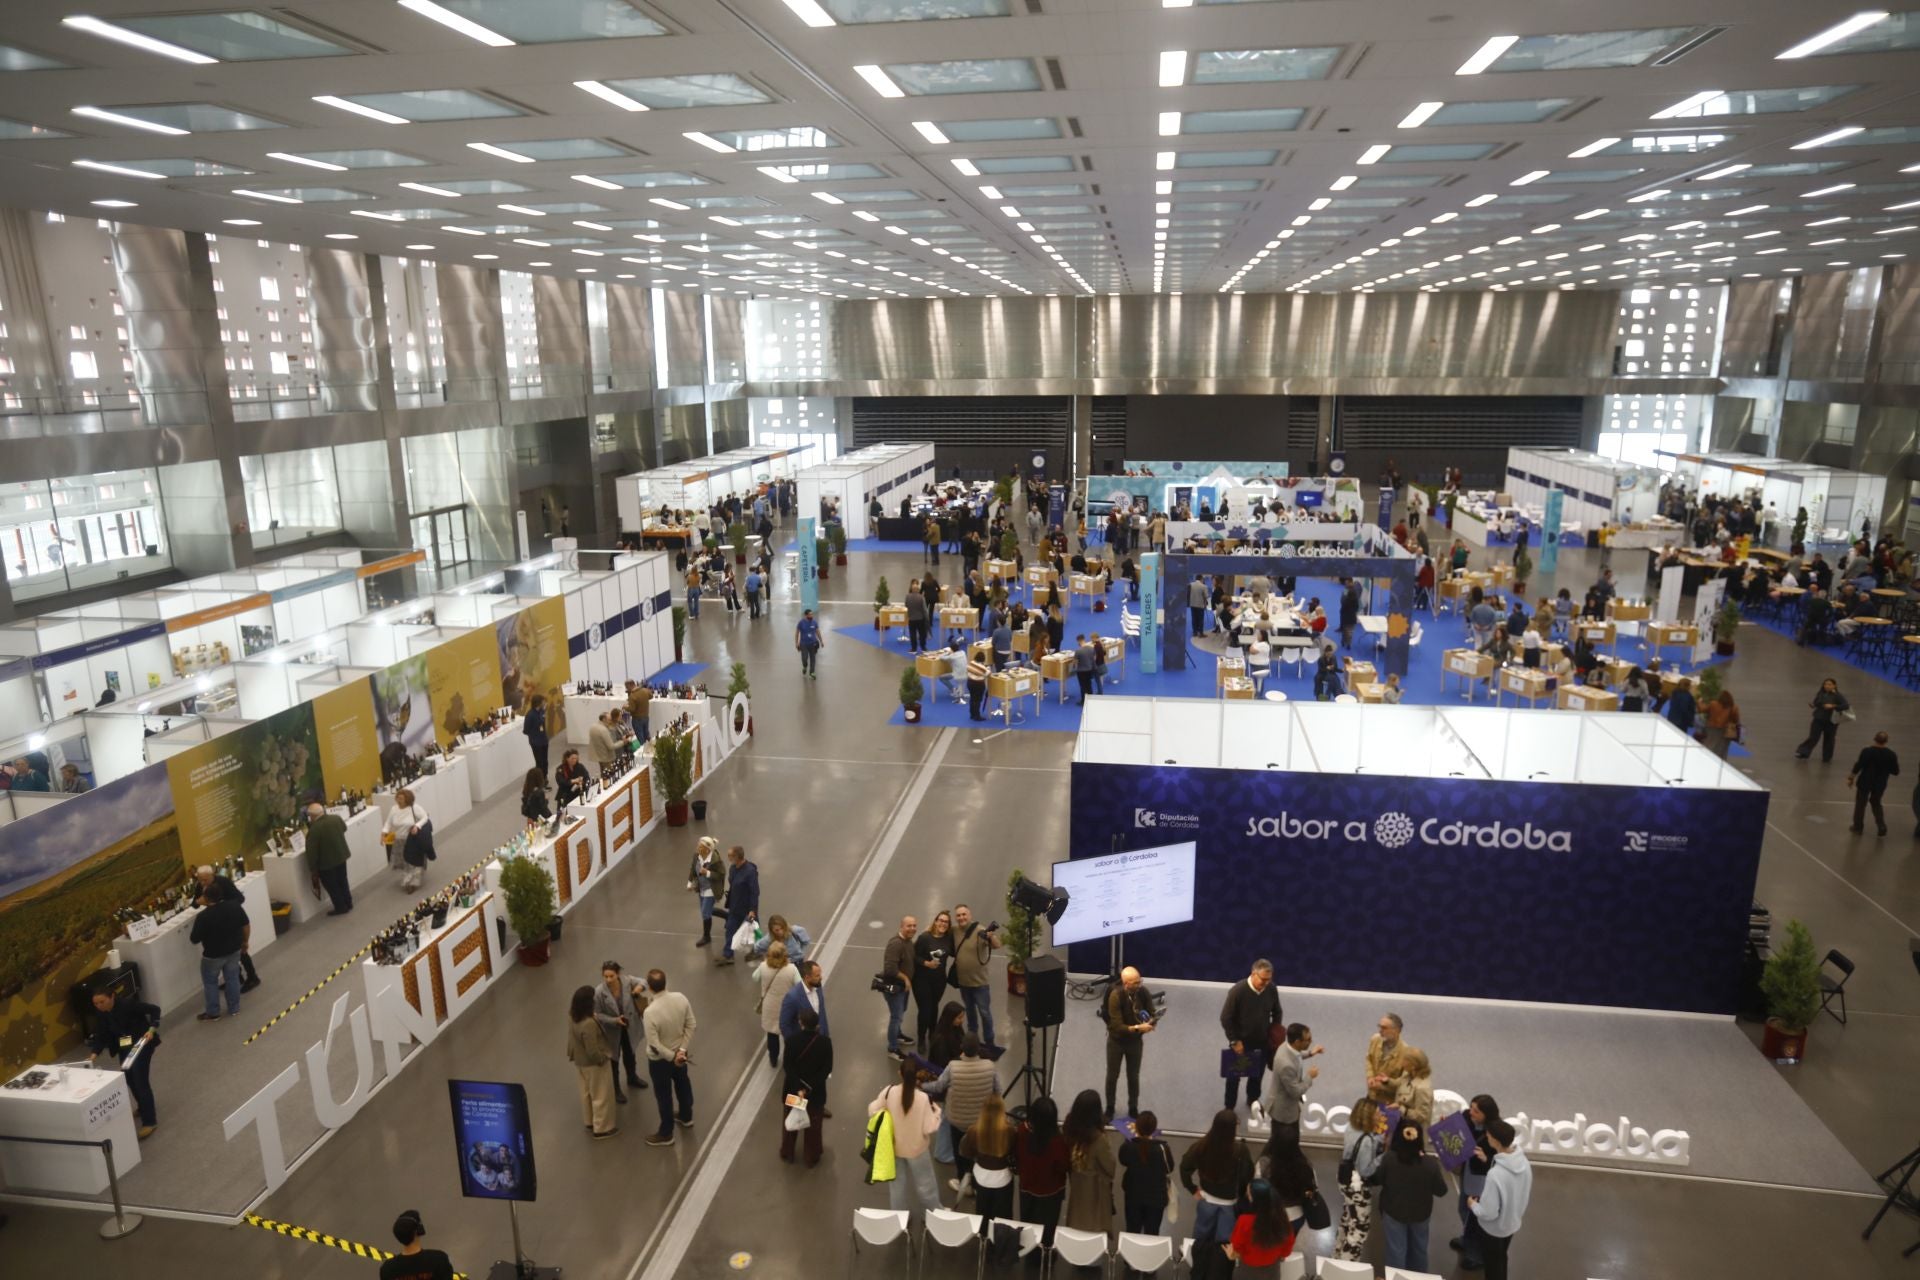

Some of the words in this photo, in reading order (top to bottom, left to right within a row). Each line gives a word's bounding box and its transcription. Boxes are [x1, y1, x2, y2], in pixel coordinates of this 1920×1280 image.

[1297, 544, 1356, 558] Córdoba
[1159, 812, 1199, 823] Diputación
[1159, 820, 1168, 828] de
[1169, 820, 1200, 830] Córdoba
[567, 779, 655, 904] DEL
[1245, 811, 1338, 840] sabor
[1343, 821, 1367, 842] a
[1419, 818, 1572, 853] Córdoba
[89, 1091, 121, 1116] ENTRADA
[1502, 1111, 1690, 1163] órdoba
